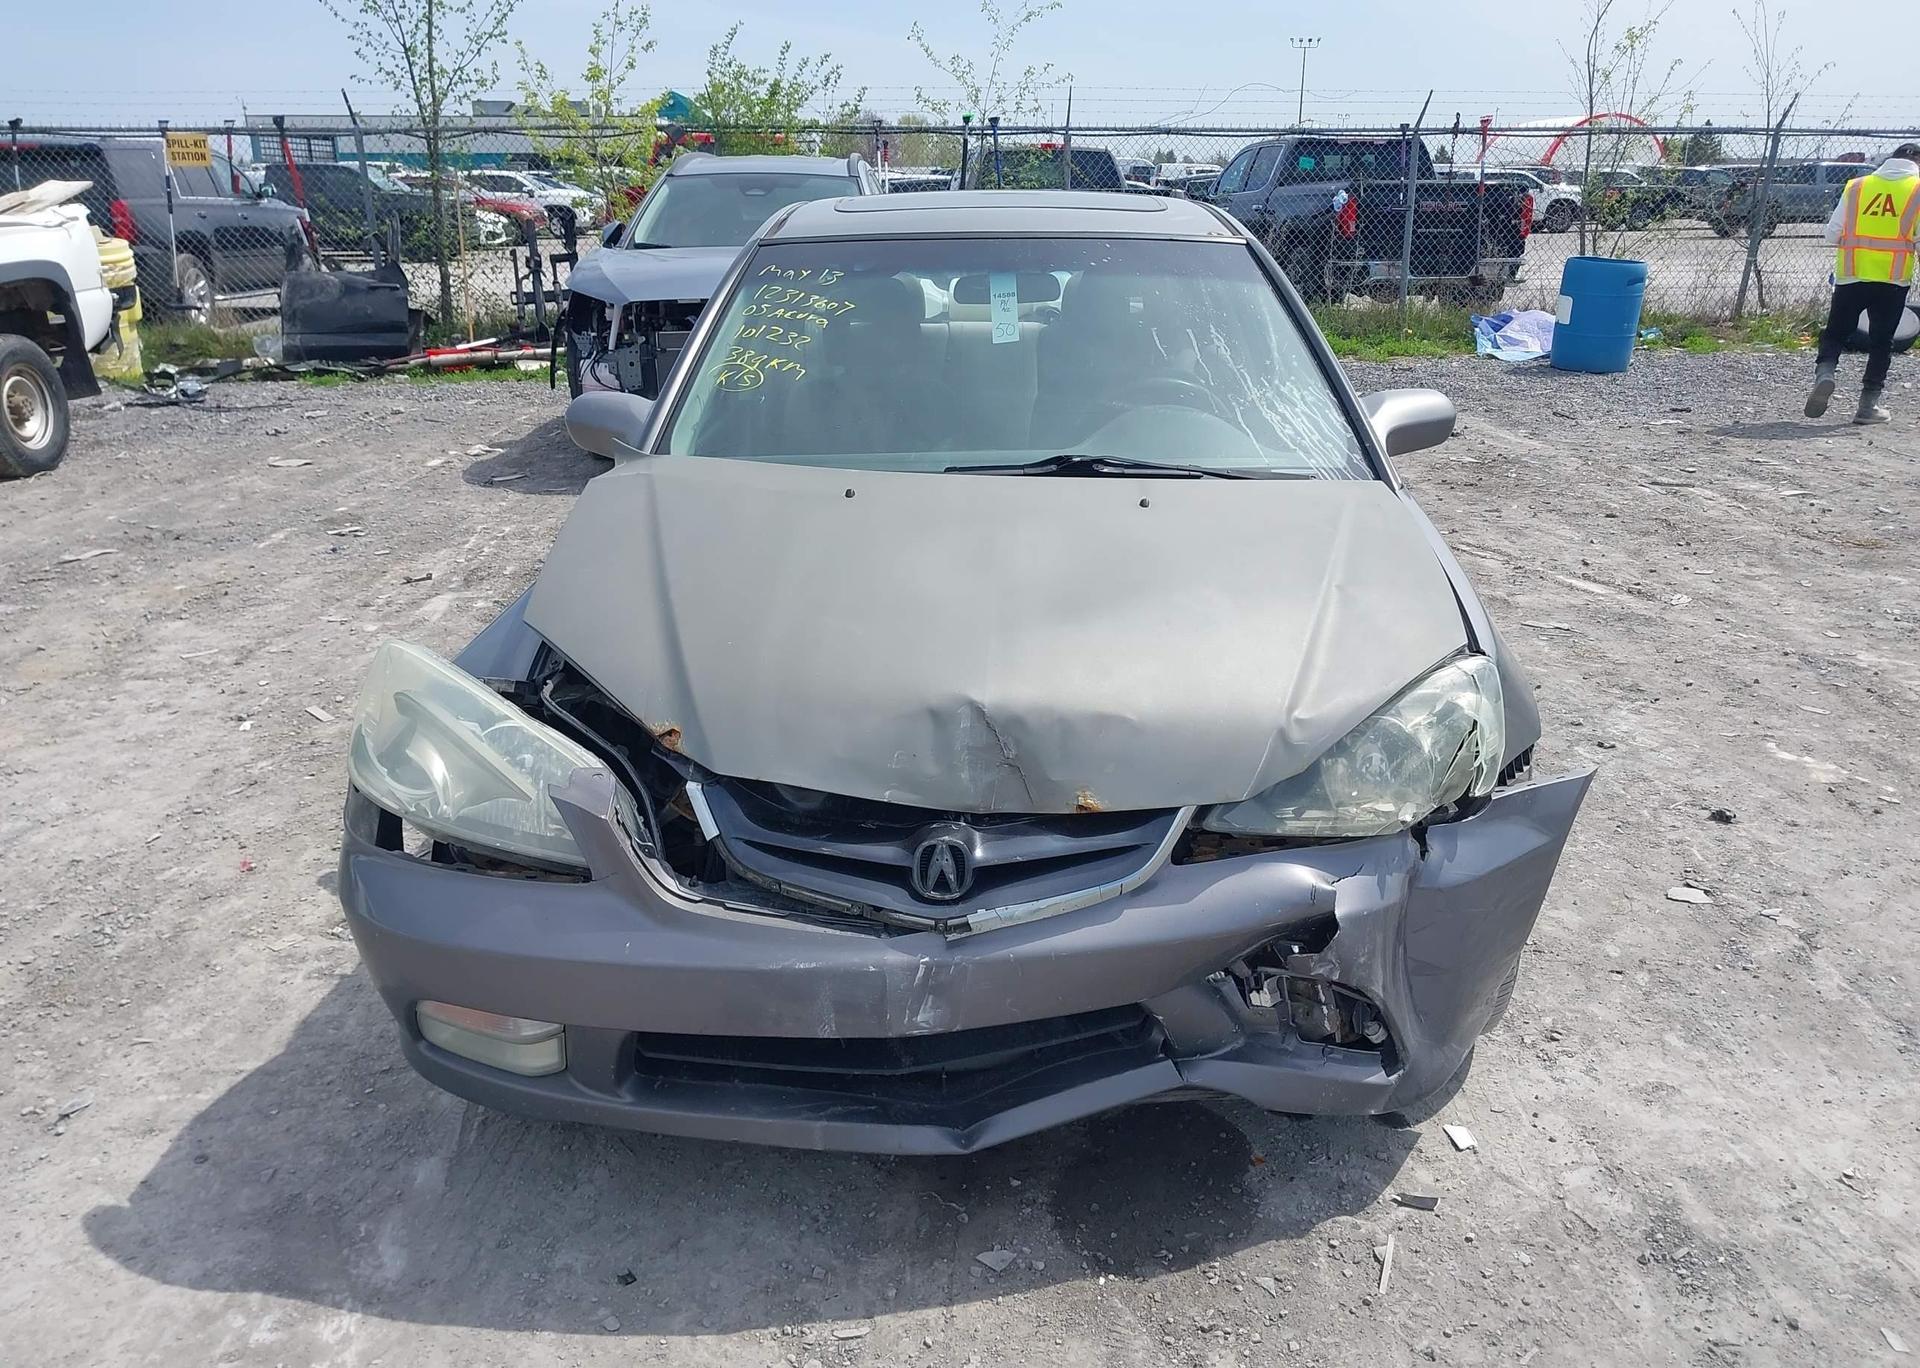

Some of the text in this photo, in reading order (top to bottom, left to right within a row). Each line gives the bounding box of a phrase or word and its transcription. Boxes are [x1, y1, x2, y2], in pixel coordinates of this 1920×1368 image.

[165, 138, 208, 149] SPILL-KIT
[171, 150, 208, 161] STATION
[818, 268, 846, 286] 13
[995, 322, 1017, 338] 50
